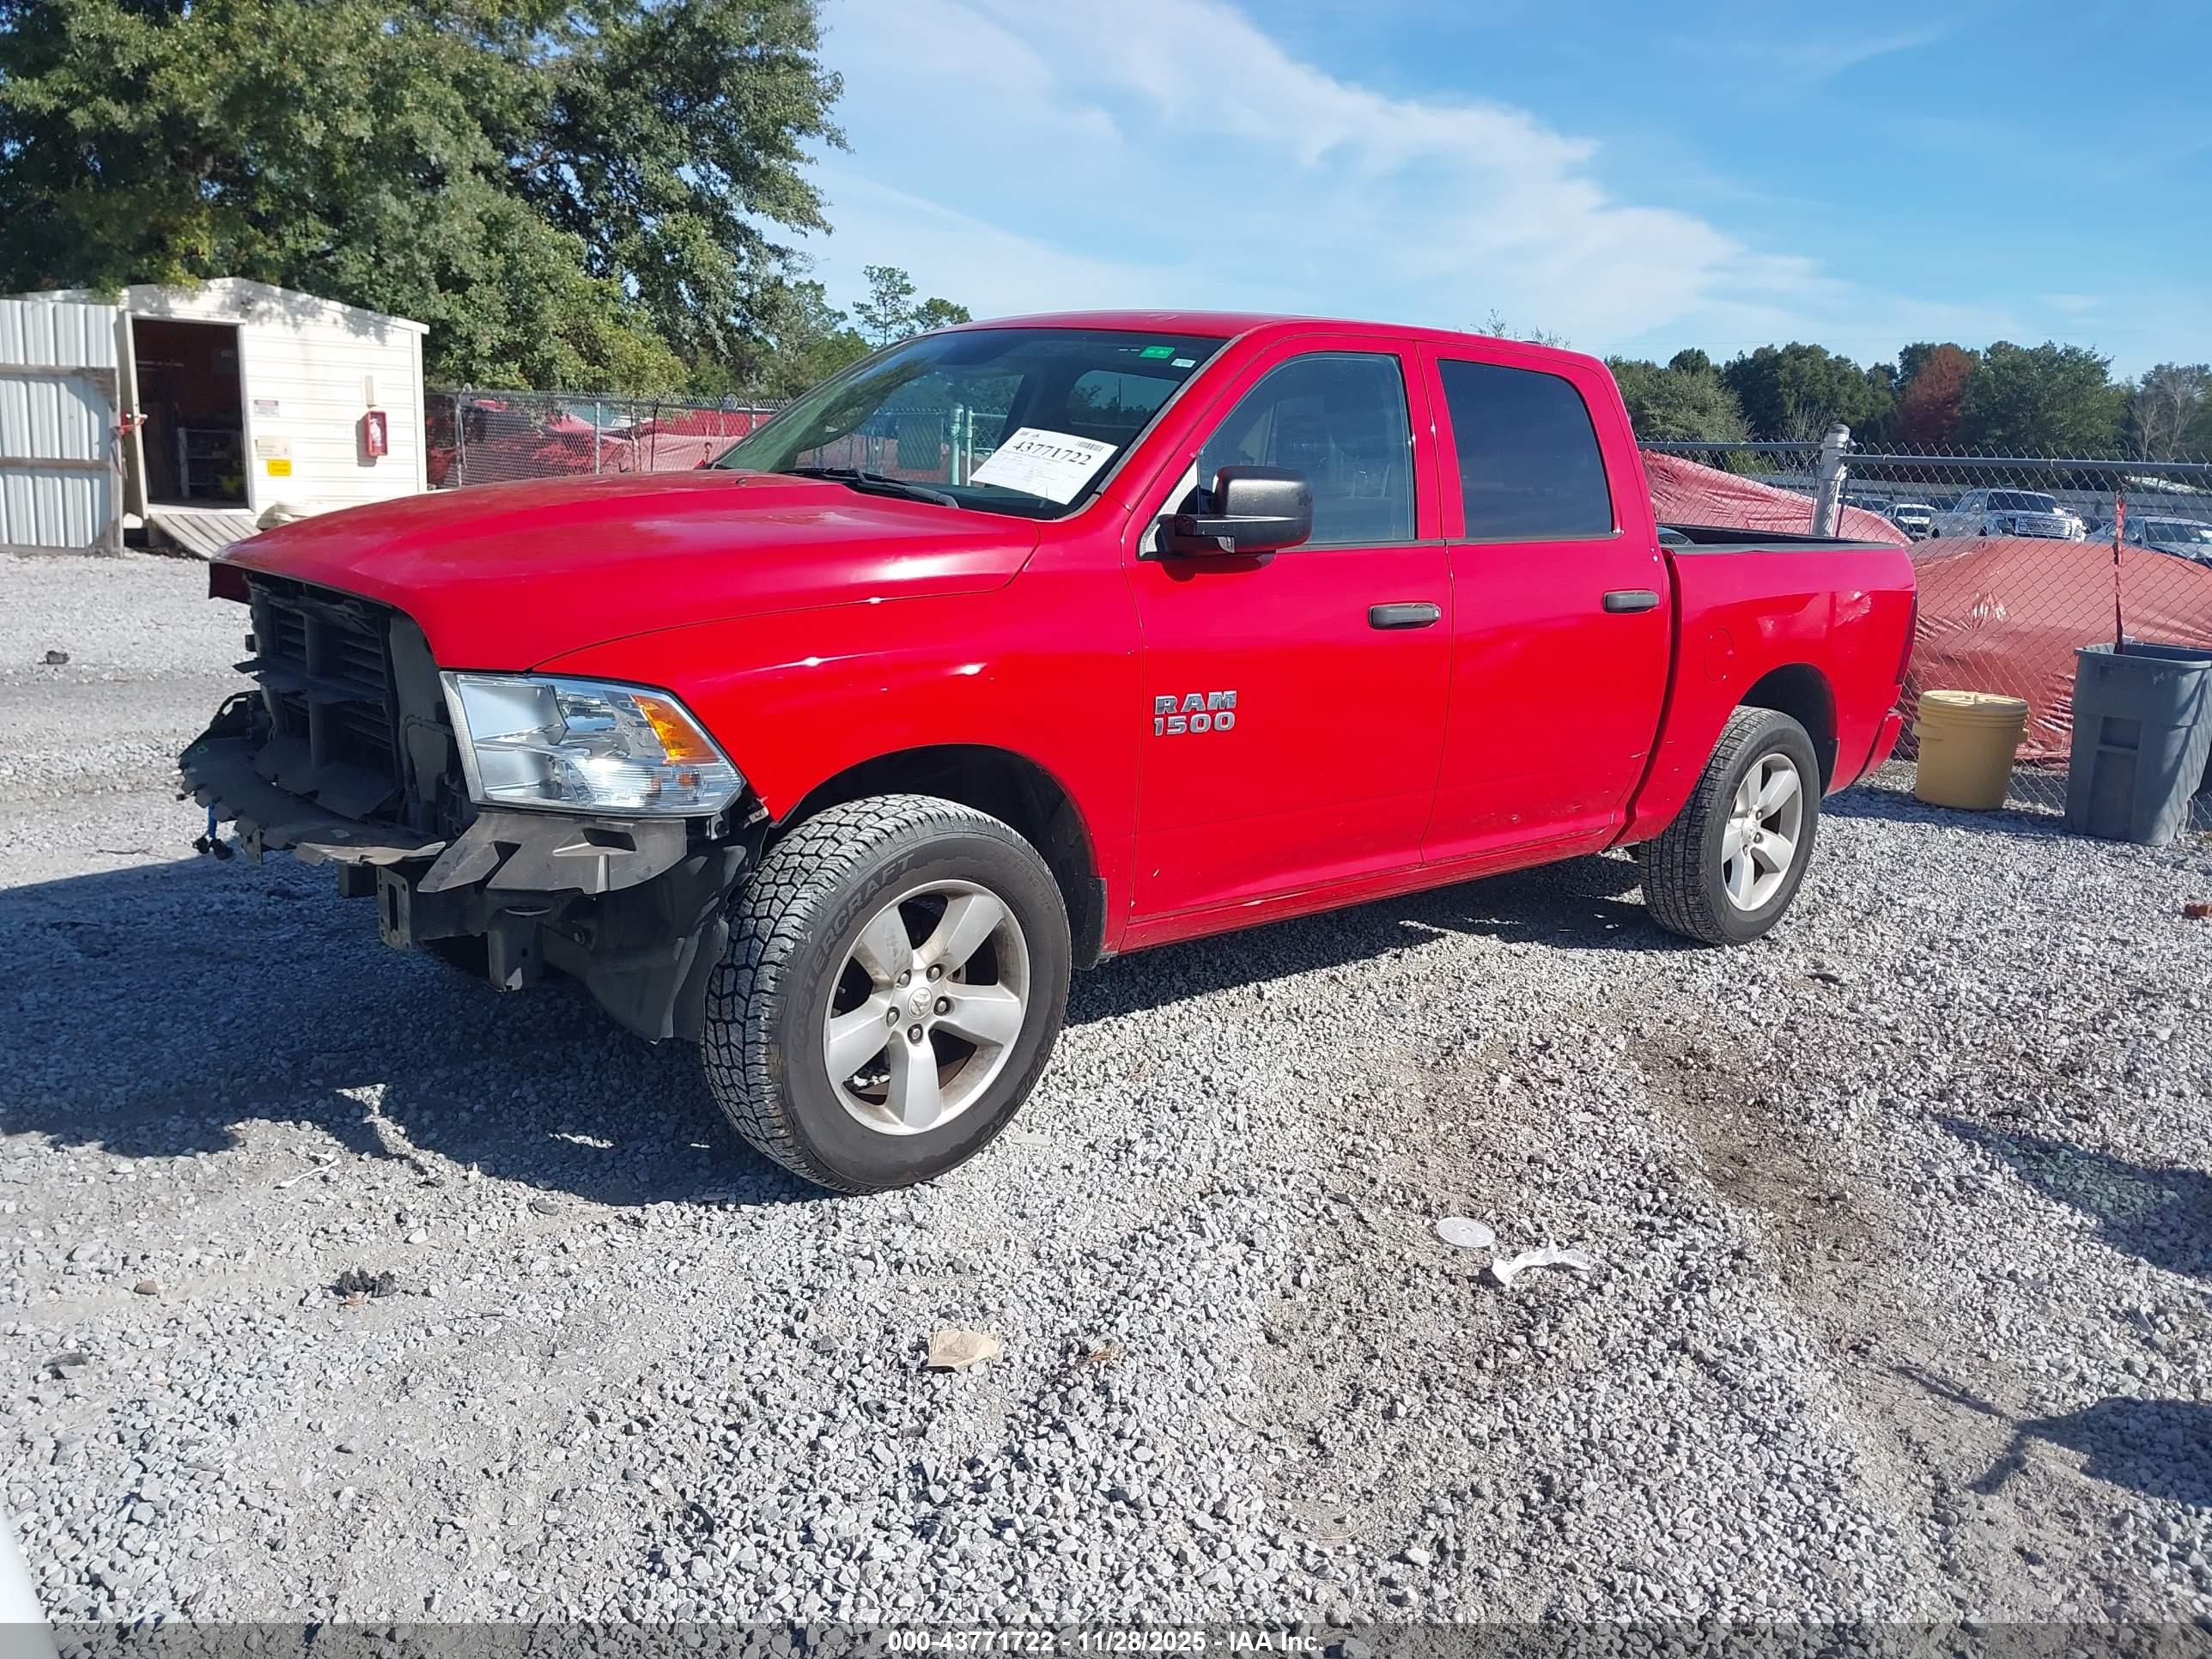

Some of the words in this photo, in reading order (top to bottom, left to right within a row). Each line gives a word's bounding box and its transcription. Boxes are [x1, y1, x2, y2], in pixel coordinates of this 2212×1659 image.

[1012, 440, 1092, 466] 43771722
[1154, 690, 1237, 715] RAM
[1153, 711, 1236, 737] 1500
